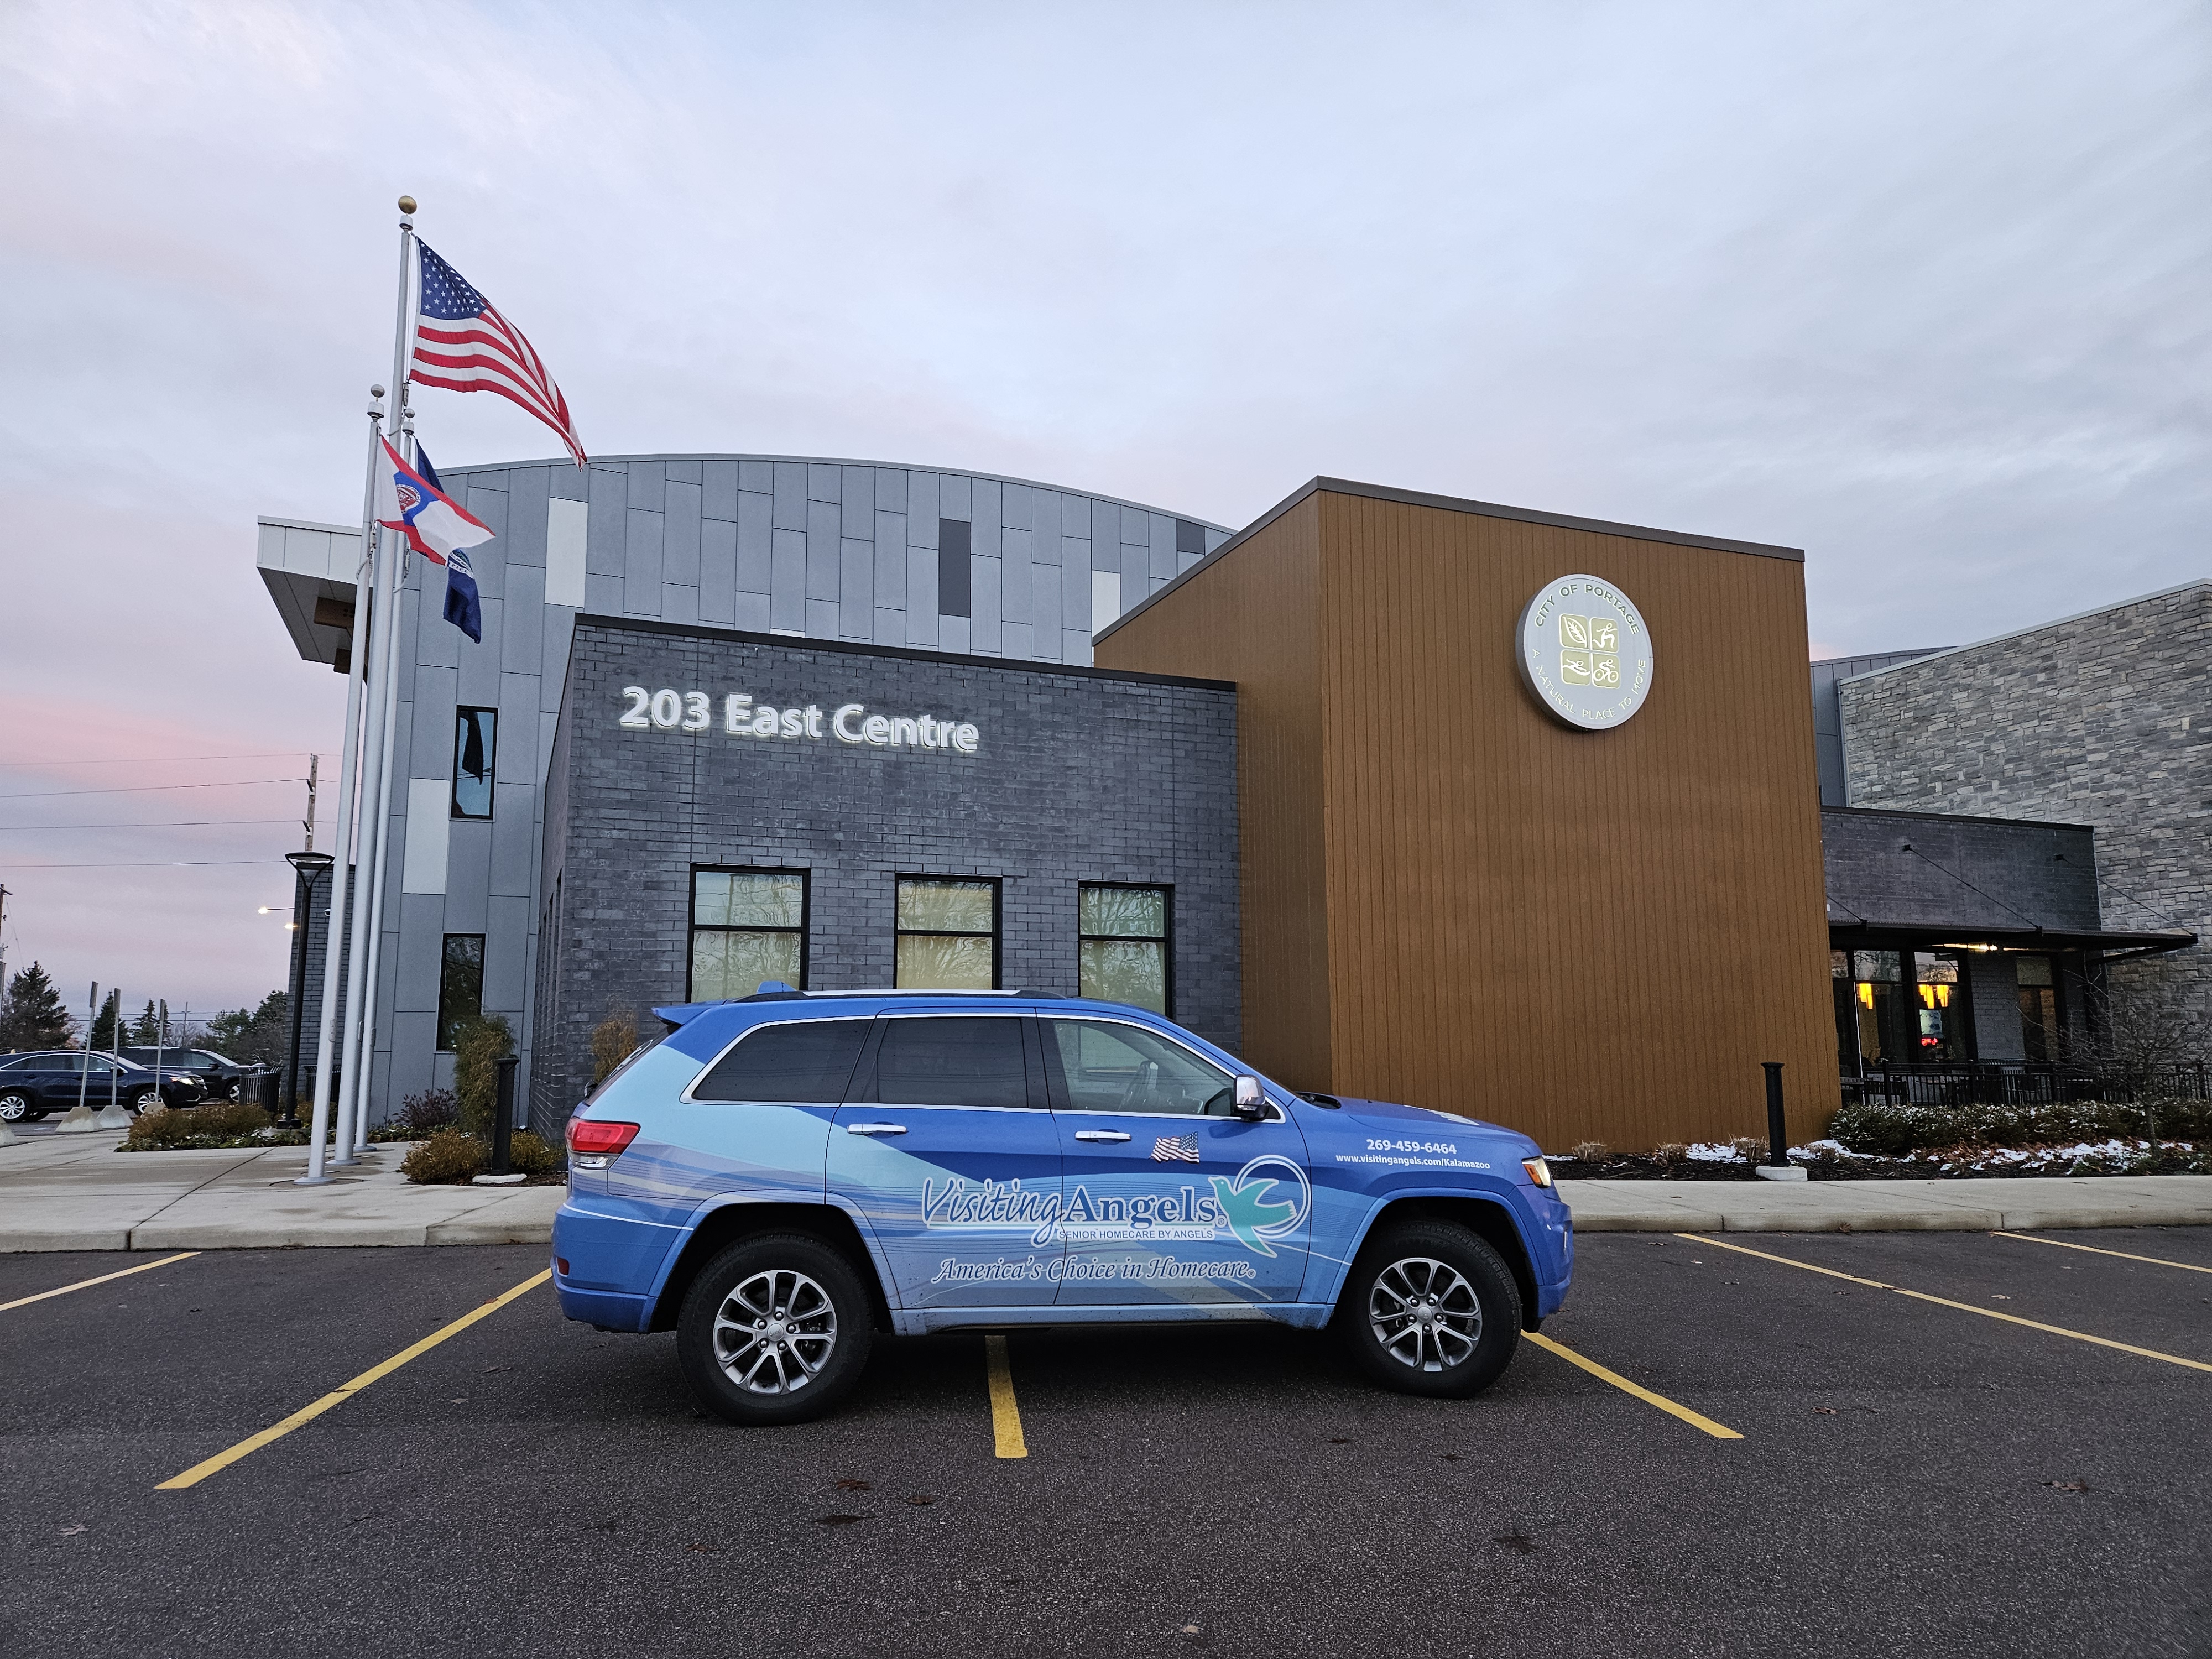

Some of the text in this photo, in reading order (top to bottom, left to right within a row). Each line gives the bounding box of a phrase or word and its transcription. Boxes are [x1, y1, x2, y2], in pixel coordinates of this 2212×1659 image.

[1535, 584, 1640, 634] CITY OF PORTAGE
[1532, 648, 1646, 720] A NATURAL PLACE TO MOVE
[619, 686, 979, 751] 203 East Centre
[1335, 1154, 1490, 1169] www.visitingangels.com/Kalamazoo
[1366, 1139, 1457, 1154] 269-459-6464
[924, 1179, 1218, 1246] Visiting Angels
[1058, 1229, 1213, 1239] SENIOR HOMECARE BY ANGELS
[931, 1256, 1043, 1283] America's
[1047, 1256, 1115, 1282] Choice
[1121, 1257, 1143, 1279] in
